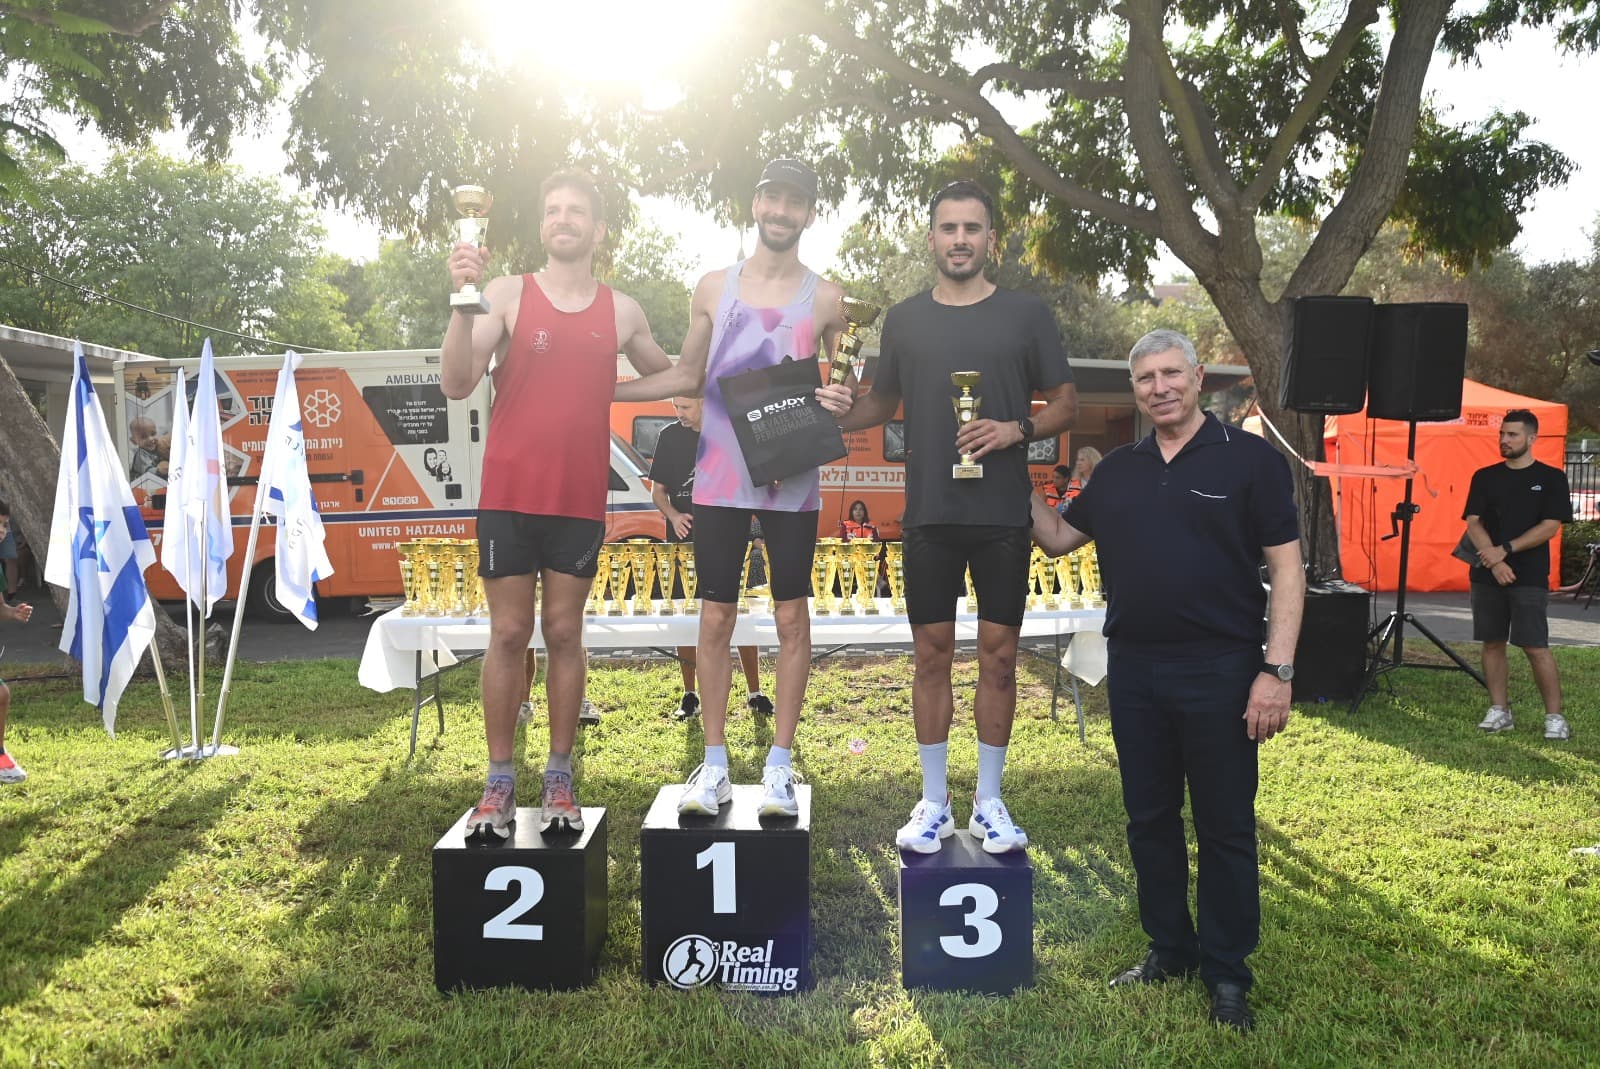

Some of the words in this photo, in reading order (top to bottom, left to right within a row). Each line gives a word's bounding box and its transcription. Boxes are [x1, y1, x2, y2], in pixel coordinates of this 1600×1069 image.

[386, 374, 442, 385] AMBULAN
[763, 396, 806, 413] RUDY
[242, 441, 266, 452] תומים
[820, 468, 849, 482] הלא
[855, 471, 906, 482] תנדבים
[359, 526, 401, 538] UNITED
[406, 523, 466, 536] HATZALAH
[372, 540, 398, 551] www.i
[697, 842, 737, 914] 1
[483, 866, 544, 941] 2
[939, 884, 1003, 959] 3
[721, 939, 774, 963] Real
[720, 961, 799, 991] Timing
